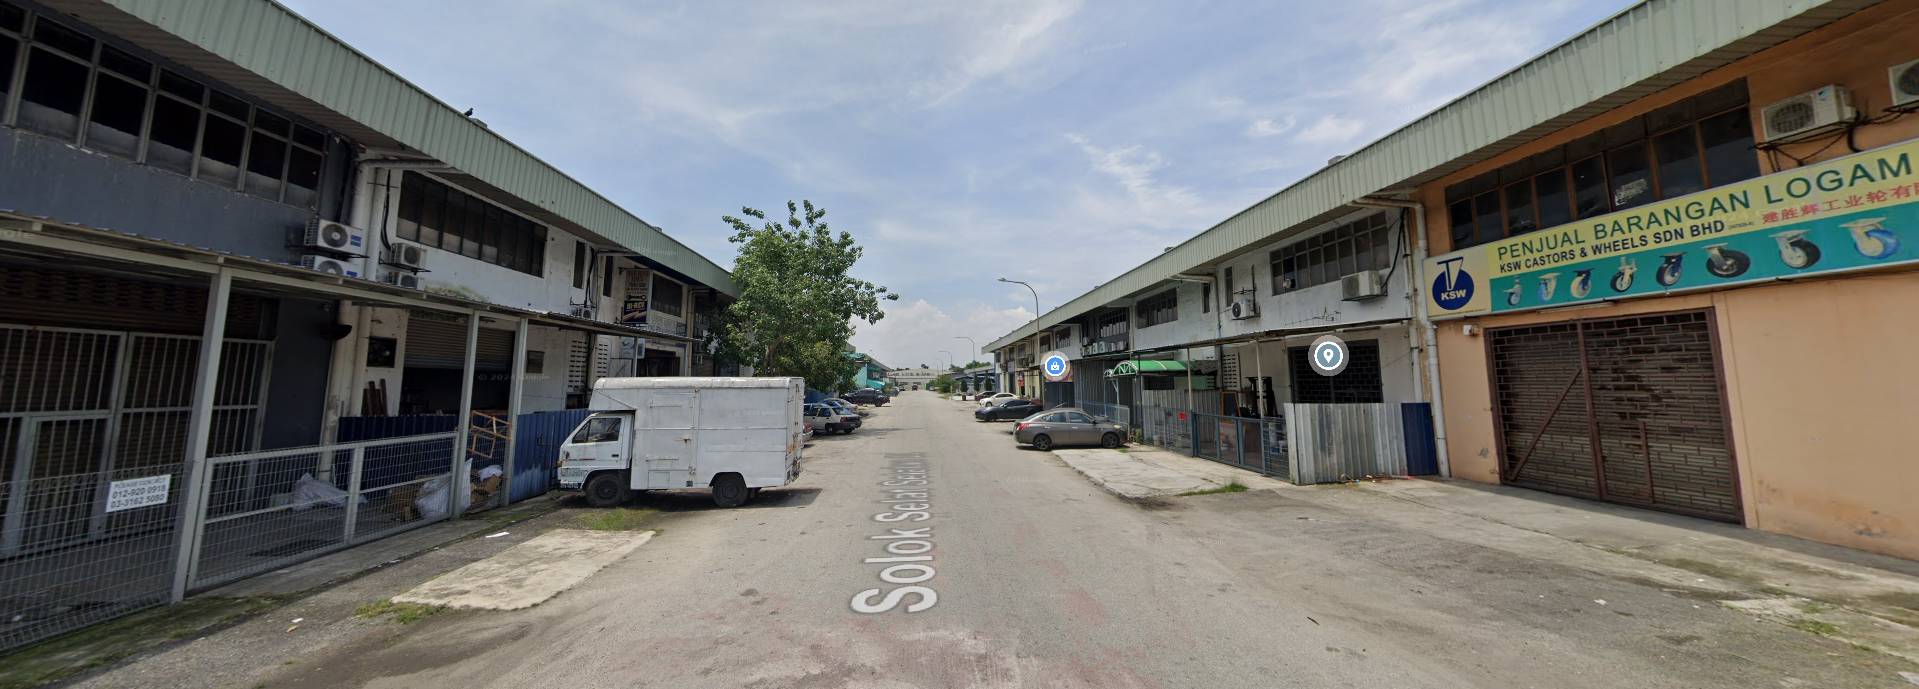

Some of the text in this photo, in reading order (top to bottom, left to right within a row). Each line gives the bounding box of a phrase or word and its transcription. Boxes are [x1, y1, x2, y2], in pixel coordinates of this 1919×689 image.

[1498, 229, 1585, 260] PENJUAL
[1594, 190, 1750, 240] BARANGAN
[1764, 152, 1912, 204] LOGAM
[1500, 261, 1521, 273] KSW
[1525, 249, 1575, 269] CASTORS
[1580, 247, 1587, 258] &
[1591, 235, 1649, 255] WHEELS
[1653, 228, 1684, 244] SDN
[1690, 220, 1725, 237] BHD
[1440, 289, 1467, 301] KSW
